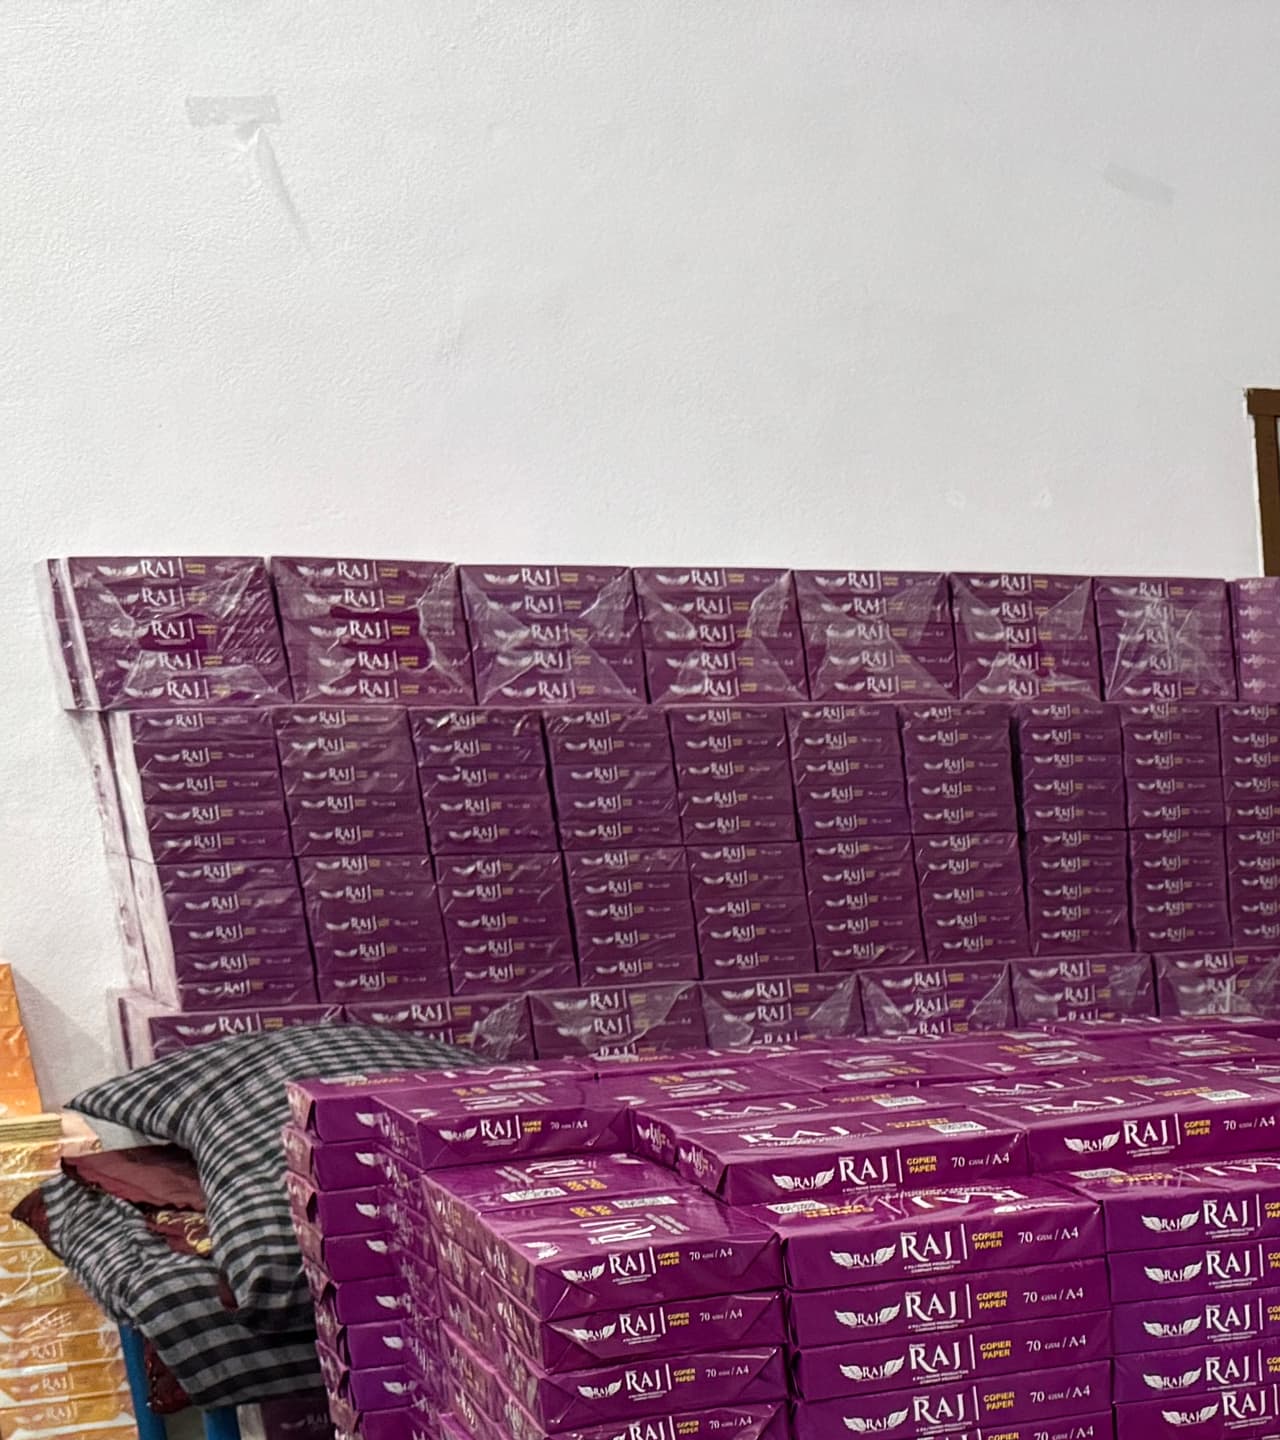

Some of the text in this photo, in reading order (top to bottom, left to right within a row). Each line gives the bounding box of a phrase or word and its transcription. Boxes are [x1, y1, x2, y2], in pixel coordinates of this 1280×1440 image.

[151, 618, 187, 641] RAJ
[900, 1230, 954, 1262] RAJ
[972, 1230, 1004, 1244] COPIER
[974, 1238, 1003, 1250] PAPER
[609, 1252, 646, 1277] RAJ
